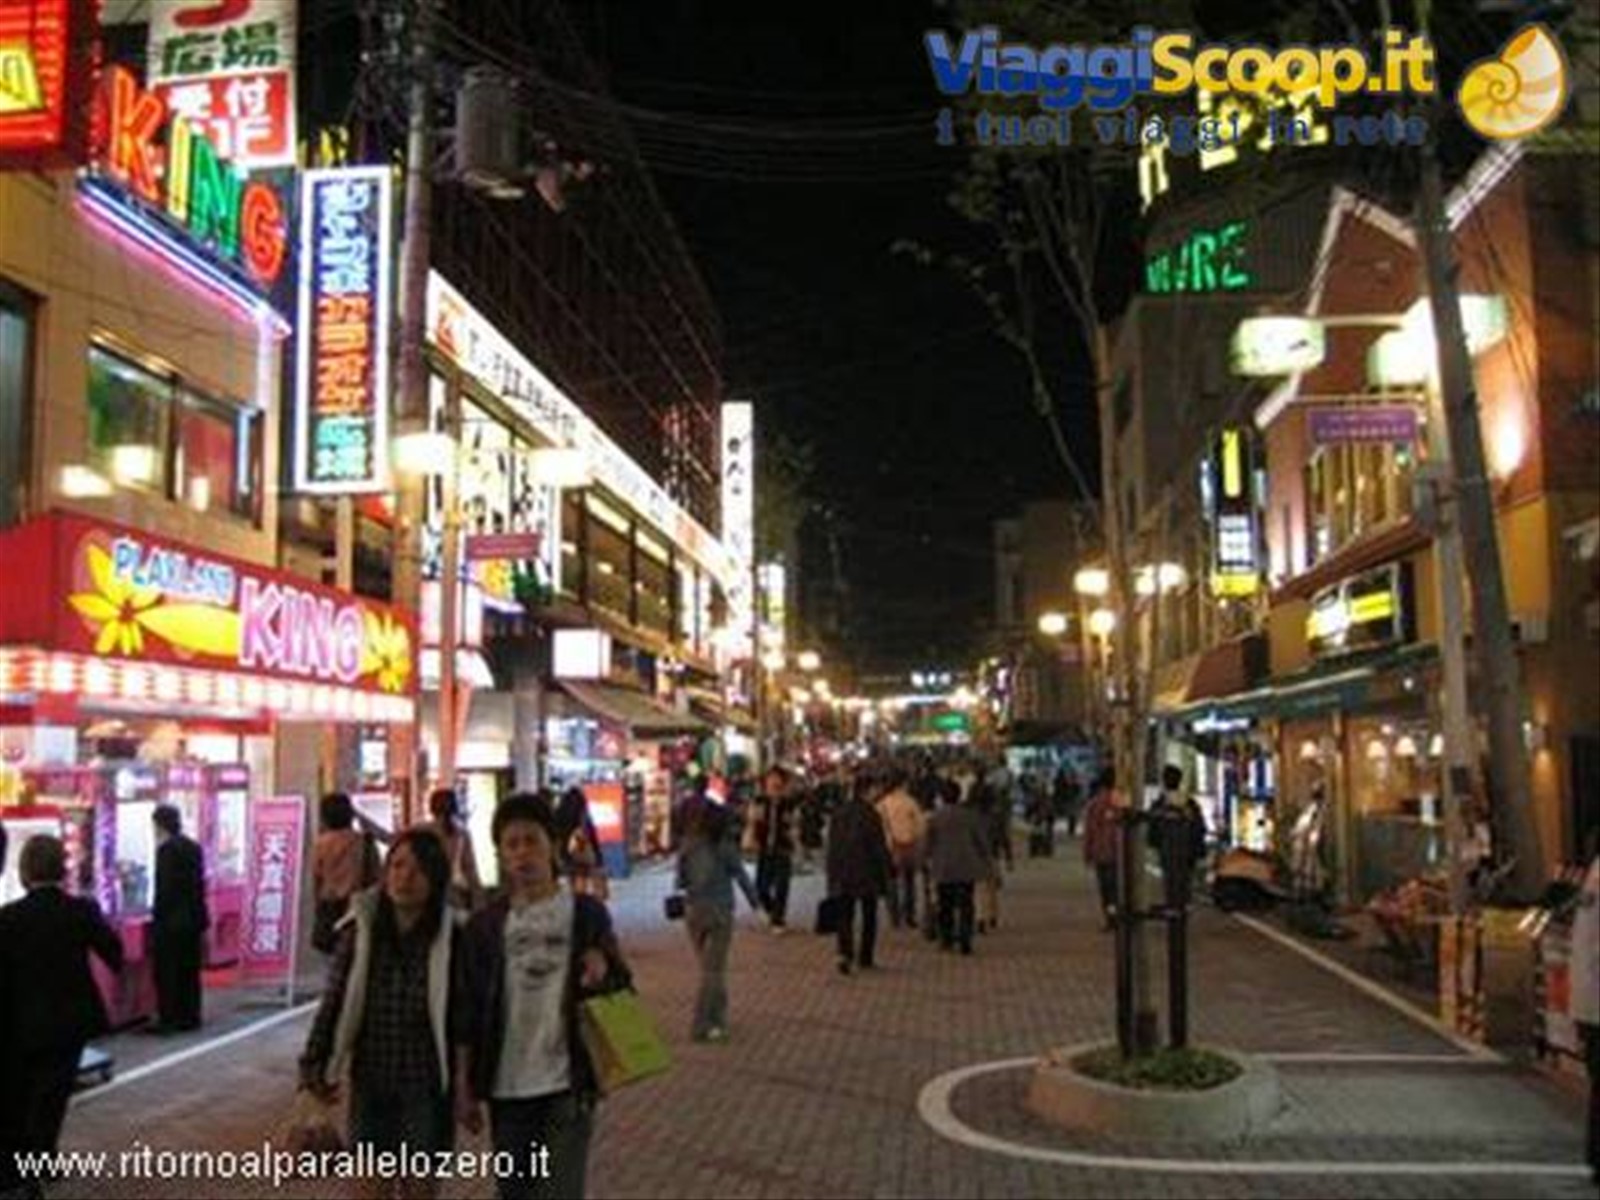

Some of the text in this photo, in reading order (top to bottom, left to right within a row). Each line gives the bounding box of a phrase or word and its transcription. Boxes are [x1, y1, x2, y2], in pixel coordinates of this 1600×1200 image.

[162, 21, 279, 77] 広場
[108, 64, 287, 284] KING
[112, 536, 236, 607] PLAYLAND
[238, 576, 364, 682] KING
